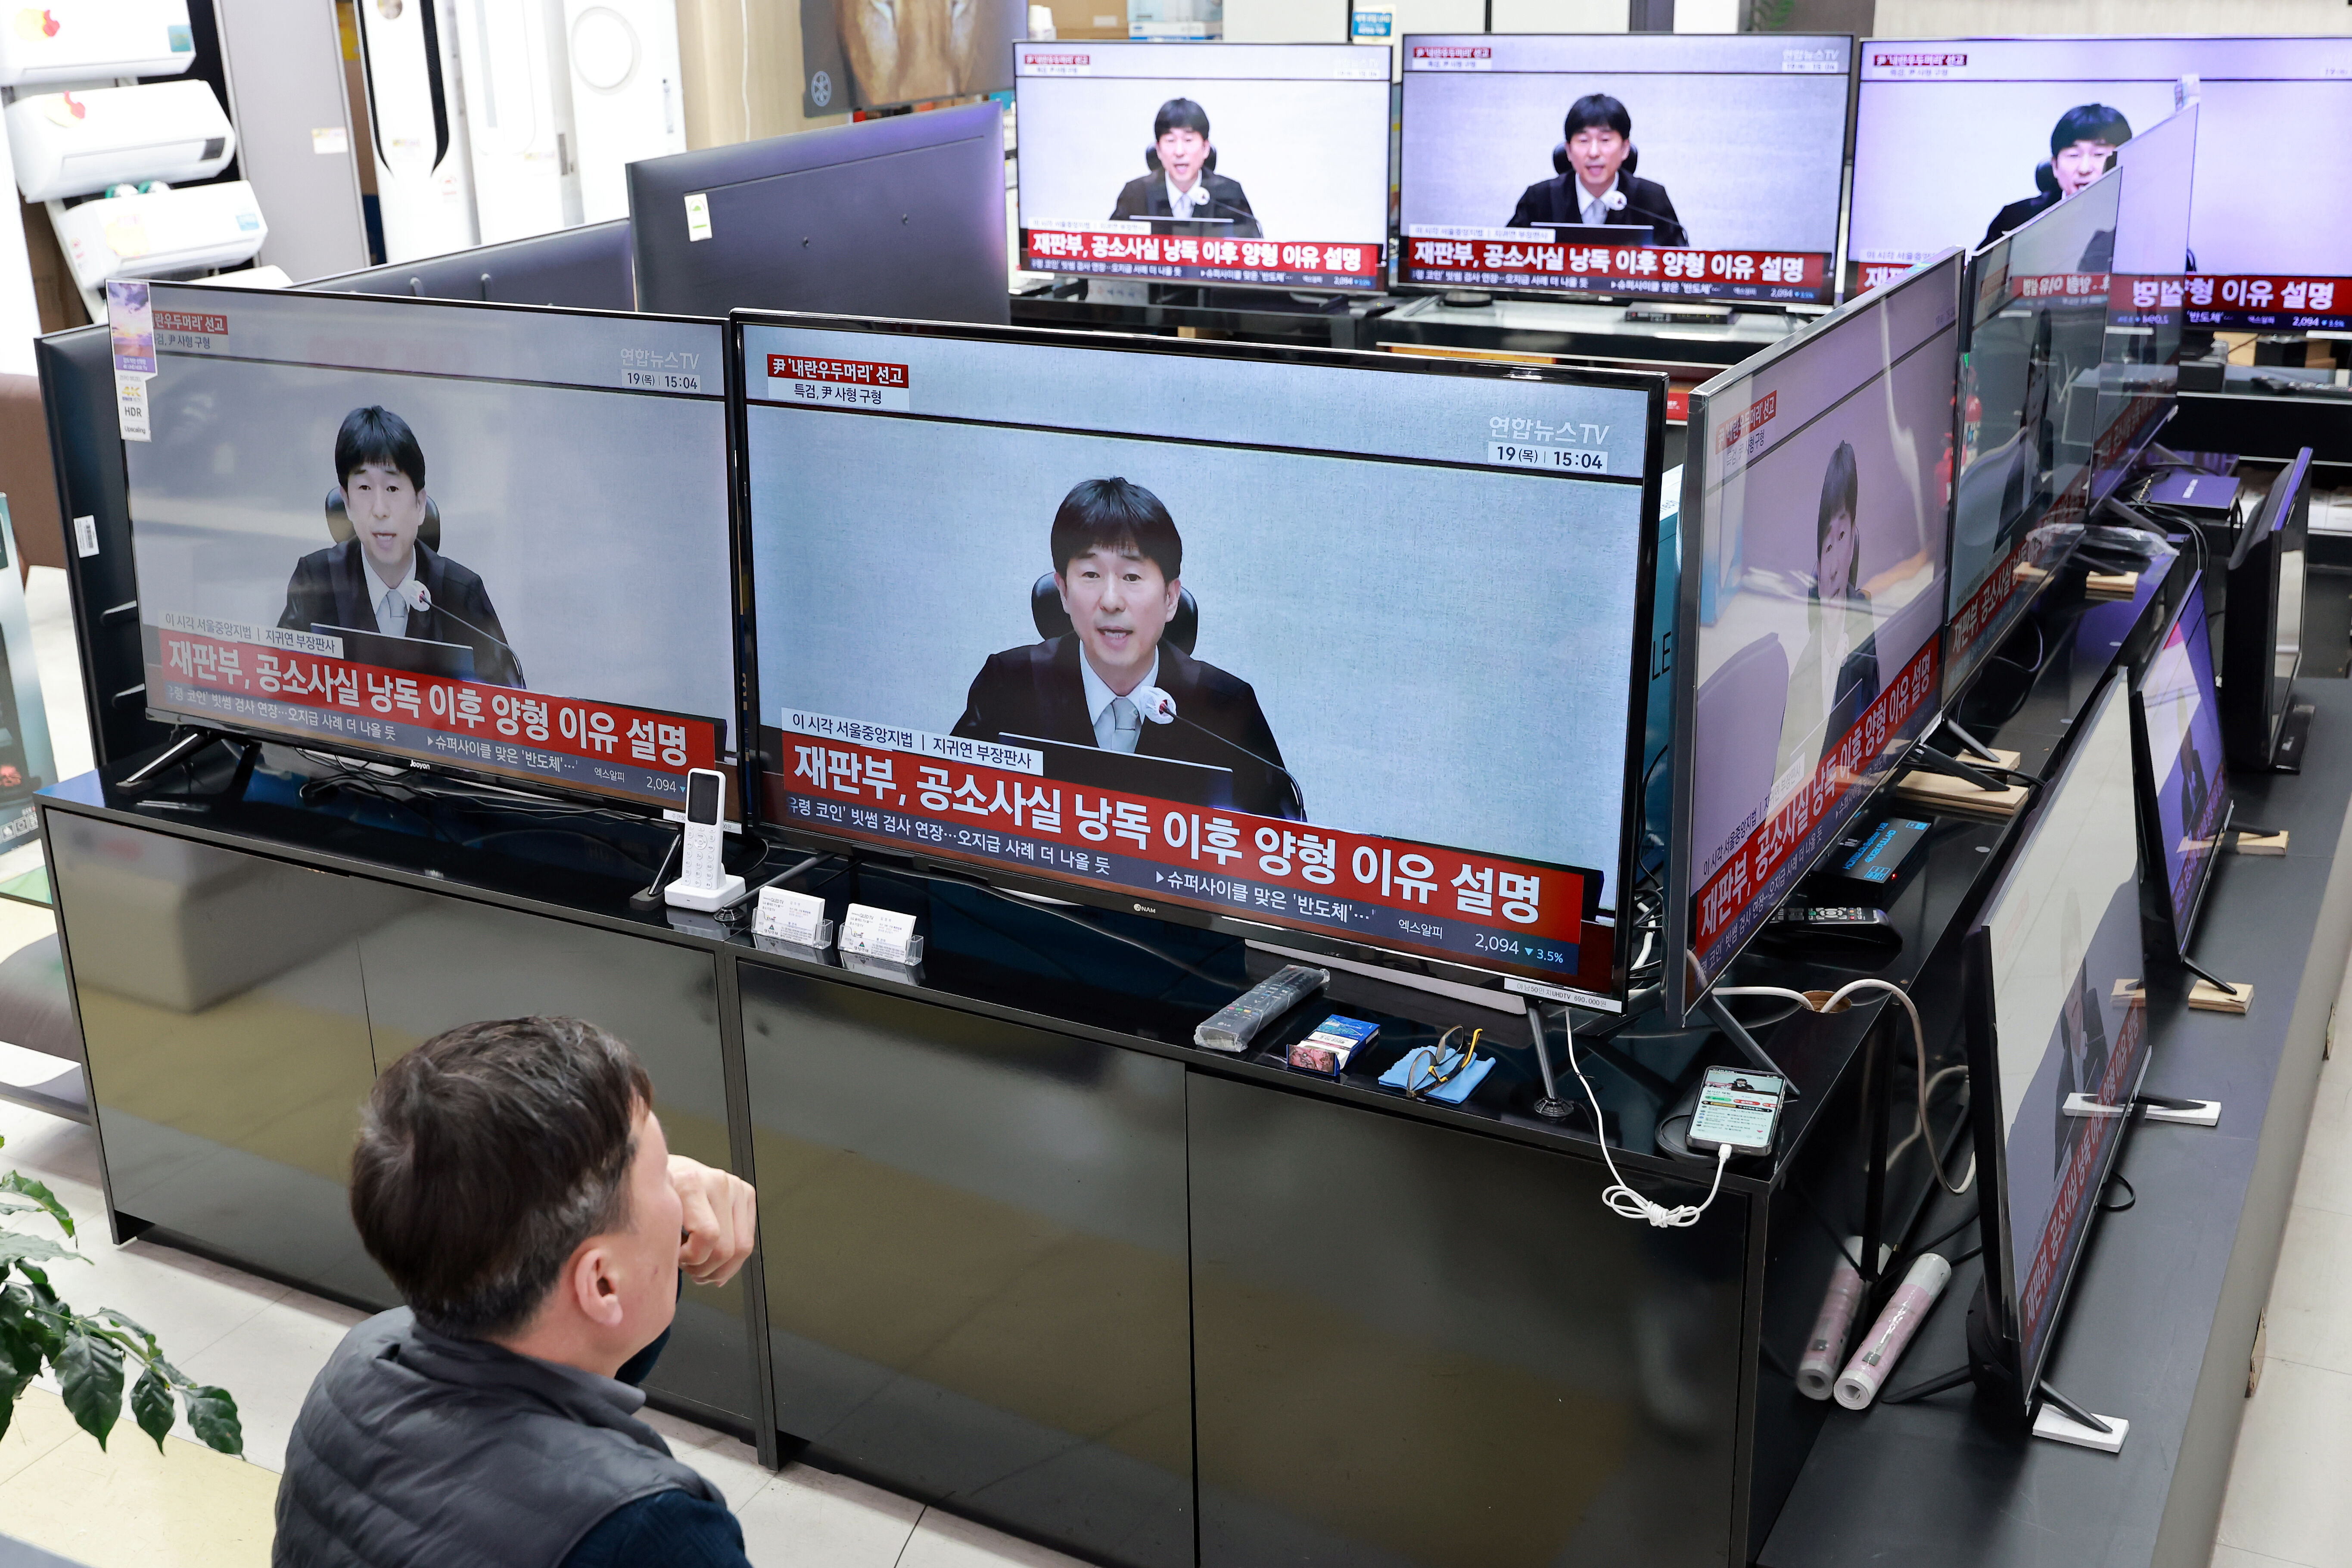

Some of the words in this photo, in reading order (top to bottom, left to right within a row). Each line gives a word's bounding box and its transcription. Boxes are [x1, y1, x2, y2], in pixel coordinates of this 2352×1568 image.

[1033, 233, 1088, 258] 재판부,
[1091, 236, 1159, 261] 공소사실
[1164, 239, 1199, 263] 낭독
[1202, 241, 1238, 264] 이후
[1242, 243, 1278, 267] 양형
[1283, 245, 1320, 269] 이유
[1323, 247, 1361, 271] 설명
[1414, 241, 1479, 268] 재판부,
[1484, 243, 1564, 271] 공소사실
[1570, 247, 1611, 274] 낭독
[1615, 249, 1658, 275] 이후
[1662, 252, 1705, 277] 양형
[1711, 254, 1755, 280] 이유
[1760, 257, 1804, 283] 설명
[2185, 277, 2214, 305] 형
[2222, 279, 2274, 308] 이유
[2280, 280, 2334, 310] 설명
[152, 313, 202, 331] 란우두머리'
[205, 317, 224, 332] 선고
[154, 333, 166, 346] 검,
[178, 335, 193, 348] 사형
[195, 336, 210, 349] 구형
[620, 348, 700, 369] 연합뉴스TV
[773, 359, 786, 374] 尹
[788, 359, 873, 382] '내란우두머리'
[876, 366, 903, 384] 선고
[628, 373, 654, 386] 19(목)
[665, 376, 697, 389] 15:04
[794, 384, 818, 400] 특검,
[821, 386, 832, 399] 尹
[835, 388, 856, 402] 사형
[860, 390, 881, 404] 구형
[124, 406, 142, 417] HDR
[1763, 396, 1774, 420] 선고
[124, 426, 146, 434] Upscaling
[1489, 416, 1610, 445] 연합뉴스TV
[1755, 429, 1764, 449] 구형
[1497, 446, 1538, 464] 19(목)
[1554, 451, 1602, 469] 15:04
[165, 614, 174, 626] 이
[177, 616, 194, 631] 시각
[197, 618, 252, 639] 서울중앙지법
[266, 632, 294, 646] 지귀연
[296, 635, 335, 653] 부장판사
[168, 640, 250, 689] 재판부,
[256, 654, 359, 707] 공소사실
[367, 673, 421, 718] 낭독
[429, 684, 485, 728] 이후
[492, 694, 550, 741] 양형
[559, 707, 619, 753] 이유
[626, 719, 688, 766] 설명
[187, 690, 208, 705] 코인'
[212, 694, 232, 710] 빗썸
[235, 698, 255, 713] 검사
[322, 713, 342, 731] 사례
[347, 719, 357, 734] 더
[361, 720, 381, 739] 나올
[385, 725, 395, 740] 듯
[435, 735, 491, 759] 슈퍼사이클
[495, 746, 518, 765] 맞은
[793, 714, 804, 729] 이
[809, 716, 832, 734] 시각
[837, 720, 912, 747] 서울중앙지법
[933, 737, 972, 758] 지귀연
[976, 744, 1031, 768] 부장판사
[410, 760, 430, 770] Jooyon
[594, 767, 625, 783] 엑스알피
[646, 775, 677, 793] 2,094
[1701, 851, 1751, 936] 재판부,
[1755, 784, 1809, 881] 공소사실
[1813, 754, 1837, 816] 낭독
[1840, 726, 1862, 779] 이후
[1866, 698, 1887, 756] 양형
[1889, 676, 1909, 724] 이유
[1912, 650, 1931, 705] 설명
[794, 744, 906, 806] 재판부,
[917, 765, 1062, 834] 공소사실
[1075, 793, 1151, 850] 낭독
[1163, 812, 1242, 865] 이후
[1254, 827, 1336, 885] 양형
[1352, 846, 1438, 904] 이유
[1450, 863, 1540, 924] 설명
[816, 803, 845, 822] 코인'
[851, 810, 878, 830] 빗썸
[883, 815, 911, 836] 검사
[1005, 839, 1034, 861] 사례
[1041, 849, 1054, 865] 더
[1061, 850, 1089, 871] 나올
[1095, 856, 1110, 876] 듯
[1704, 858, 1709, 875] 이
[1711, 844, 1723, 868] 시각
[1724, 808, 1757, 855] 서울중앙지법
[1167, 871, 1248, 902] 슈퍼사이클
[1254, 887, 1286, 910] 맞은
[1725, 923, 1738, 952] 빗썸
[1739, 908, 1751, 935] 검사
[1787, 853, 1798, 876] 사례
[1799, 846, 1804, 862] 더
[1805, 834, 1816, 854] 나올
[1817, 825, 1823, 844] 듯
[1399, 919, 1443, 939] 엑스알피
[1475, 933, 1519, 955] 2,094
[1537, 949, 1563, 964] 3.5%
[1517, 983, 1571, 999] 아남50인치UHDTV
[1574, 996, 1606, 1007] 690.000원
[2026, 1244, 2050, 1327] 재판부,
[2050, 1164, 2078, 1261] 공소사실
[2077, 1129, 2091, 1186] 낭독
[2116, 1034, 2128, 1077] 이유
[2128, 1003, 2139, 1052] 설명
